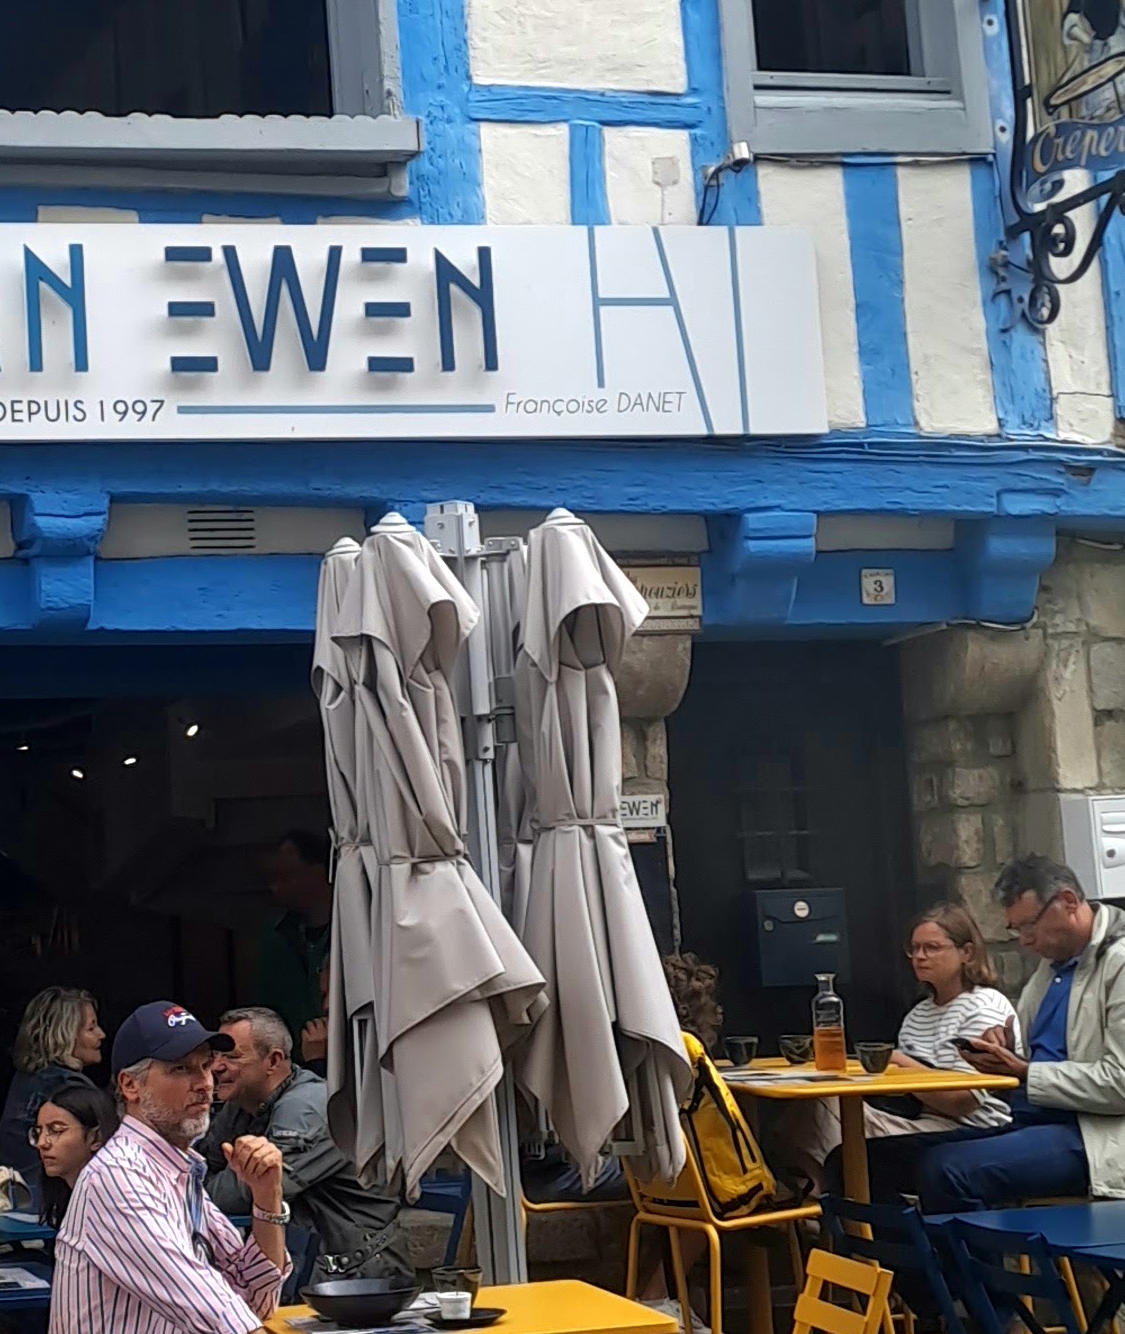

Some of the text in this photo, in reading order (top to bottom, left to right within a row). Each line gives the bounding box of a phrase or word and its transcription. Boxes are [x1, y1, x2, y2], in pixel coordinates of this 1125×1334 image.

[164, 244, 500, 373] EWEN
[99, 399, 166, 424] 1997
[504, 390, 687, 418] Françoise DANET
[873, 579, 885, 593] 3
[620, 799, 659, 817] EWEN
